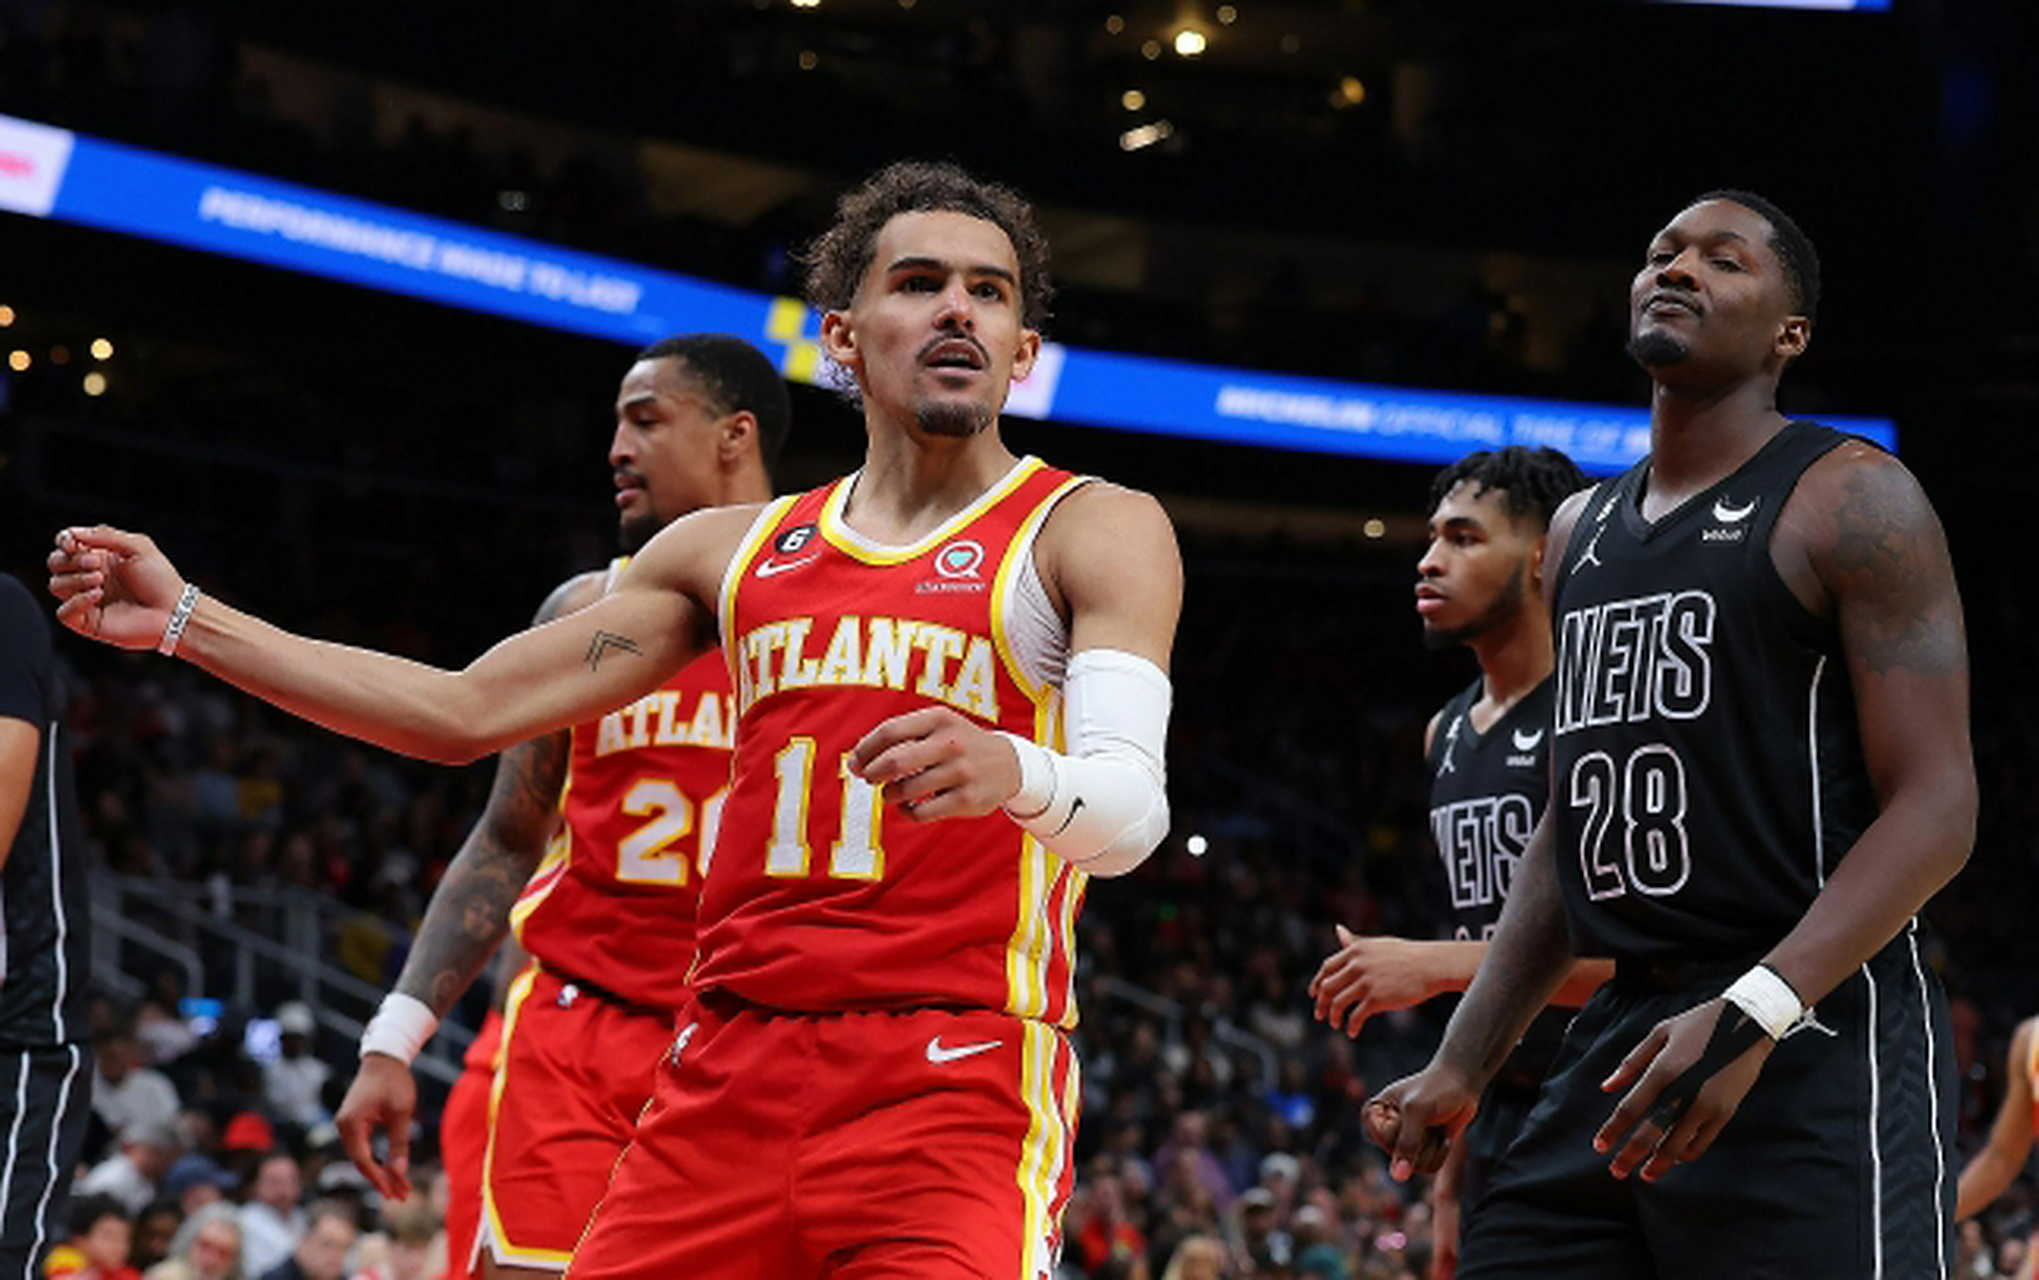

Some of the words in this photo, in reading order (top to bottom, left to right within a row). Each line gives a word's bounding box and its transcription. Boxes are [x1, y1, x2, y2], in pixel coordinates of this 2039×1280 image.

[781, 528, 810, 552] 6
[739, 614, 999, 724] ATLANTA
[1555, 590, 1716, 735] NETS
[764, 735, 886, 883] 11
[1570, 743, 1690, 900] 28
